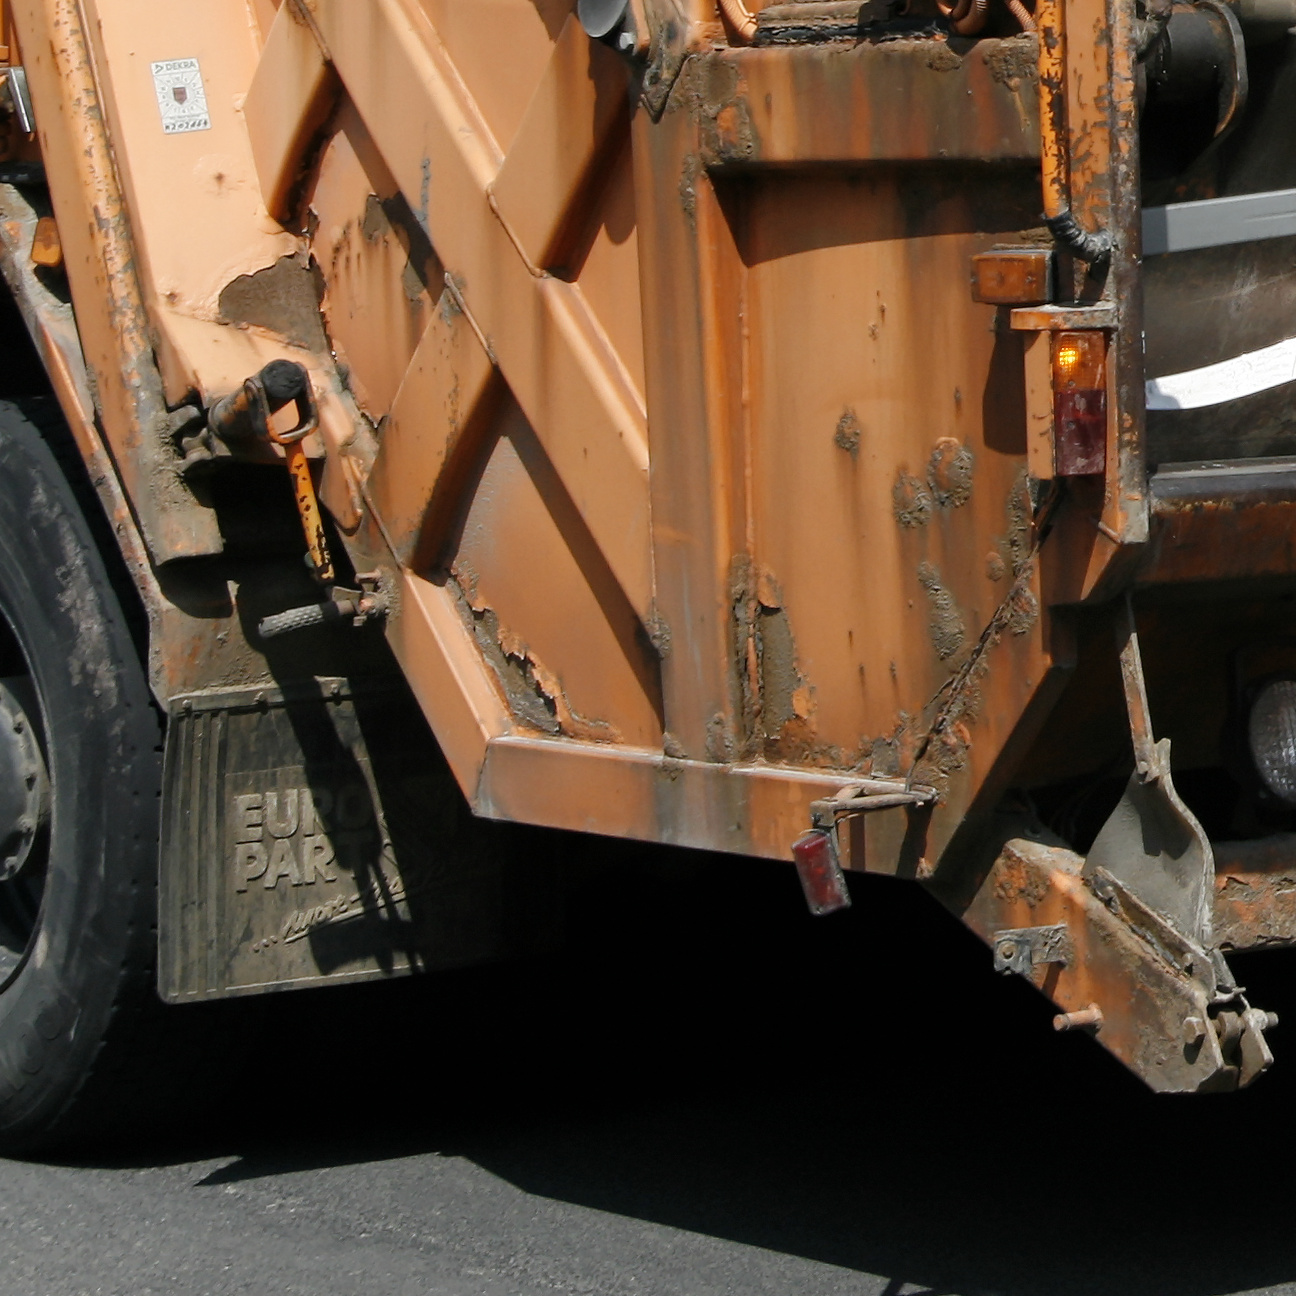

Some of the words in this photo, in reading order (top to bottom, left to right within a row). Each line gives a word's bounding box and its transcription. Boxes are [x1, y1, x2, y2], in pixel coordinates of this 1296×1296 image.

[165, 61, 197, 71] DEKRA
[234, 784, 375, 844] EURO
[235, 830, 381, 894] PART
